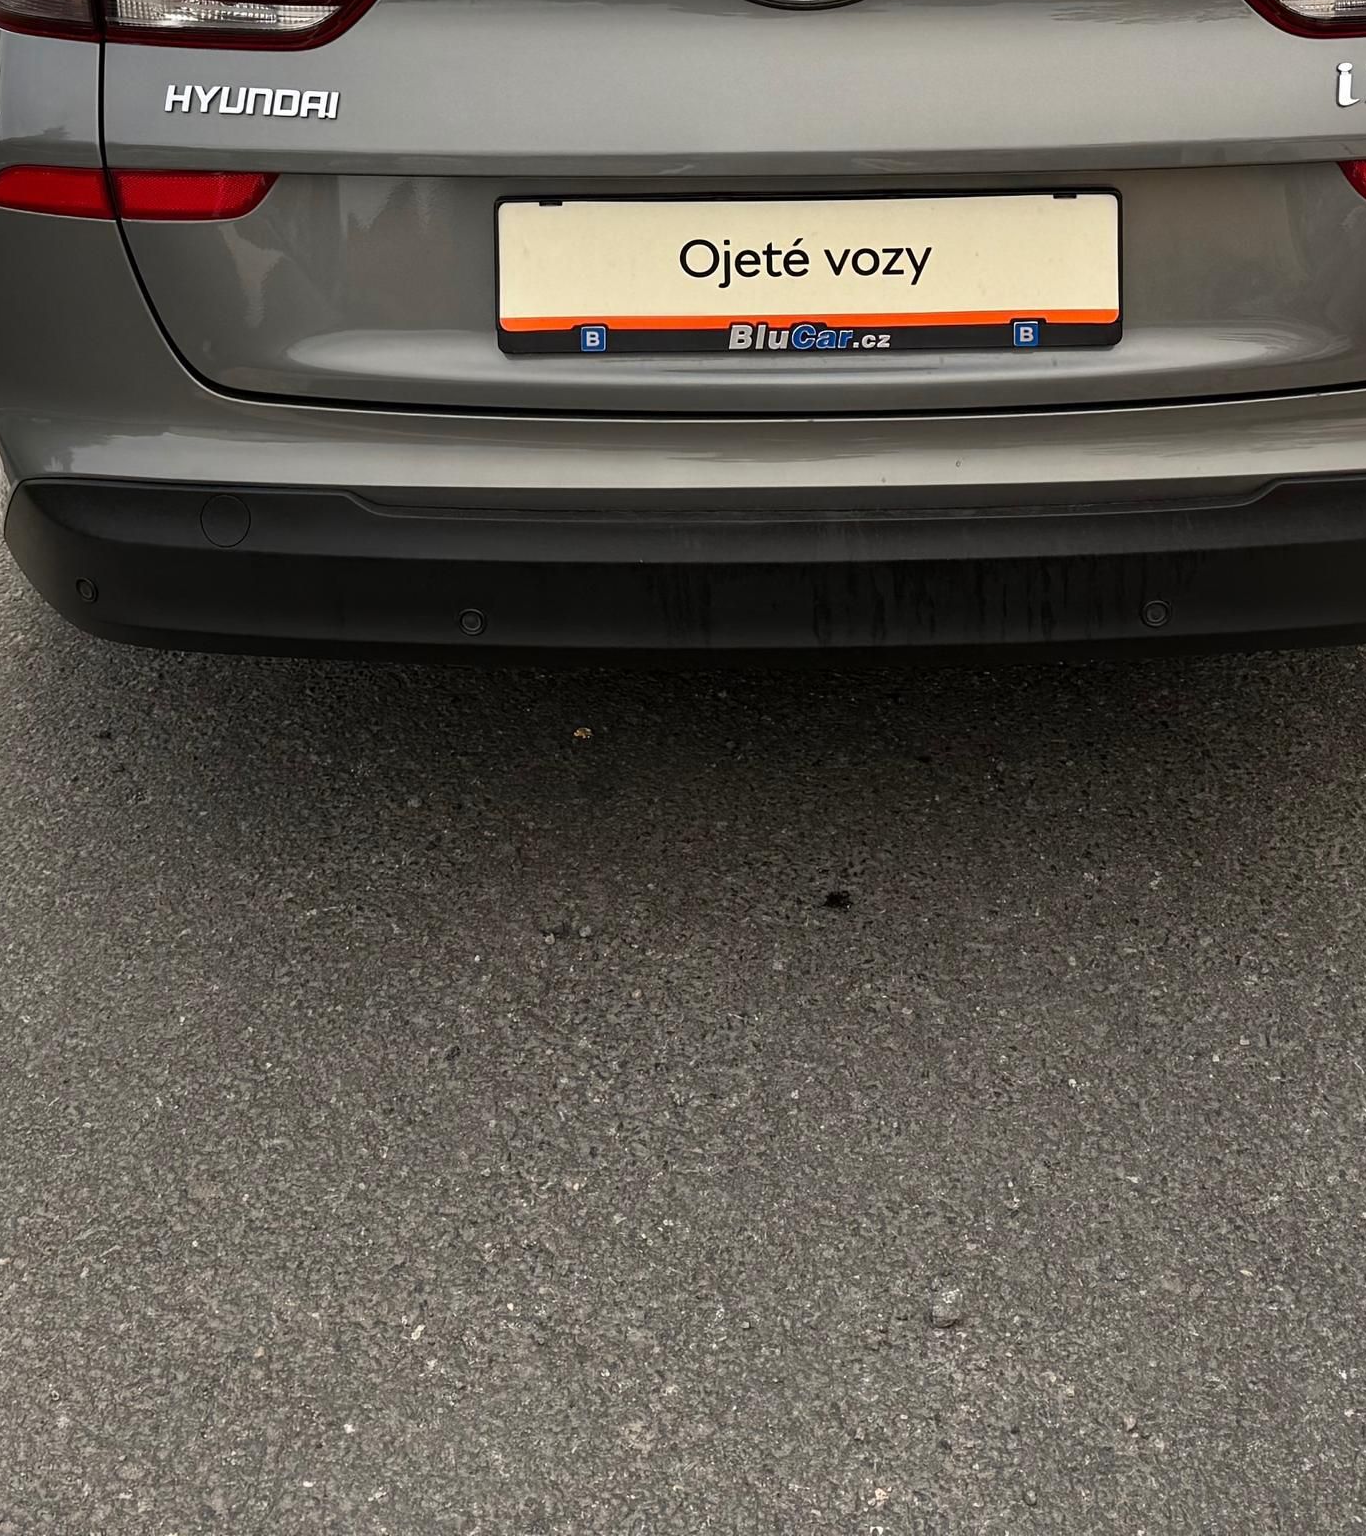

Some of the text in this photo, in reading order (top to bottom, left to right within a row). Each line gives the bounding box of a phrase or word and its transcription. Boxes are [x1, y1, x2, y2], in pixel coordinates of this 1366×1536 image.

[164, 84, 340, 119] HYUNDAI
[679, 238, 932, 288] Ojeté vozy
[586, 331, 600, 347] B
[728, 324, 891, 350] BluCar.cz
[1019, 326, 1034, 342] B
